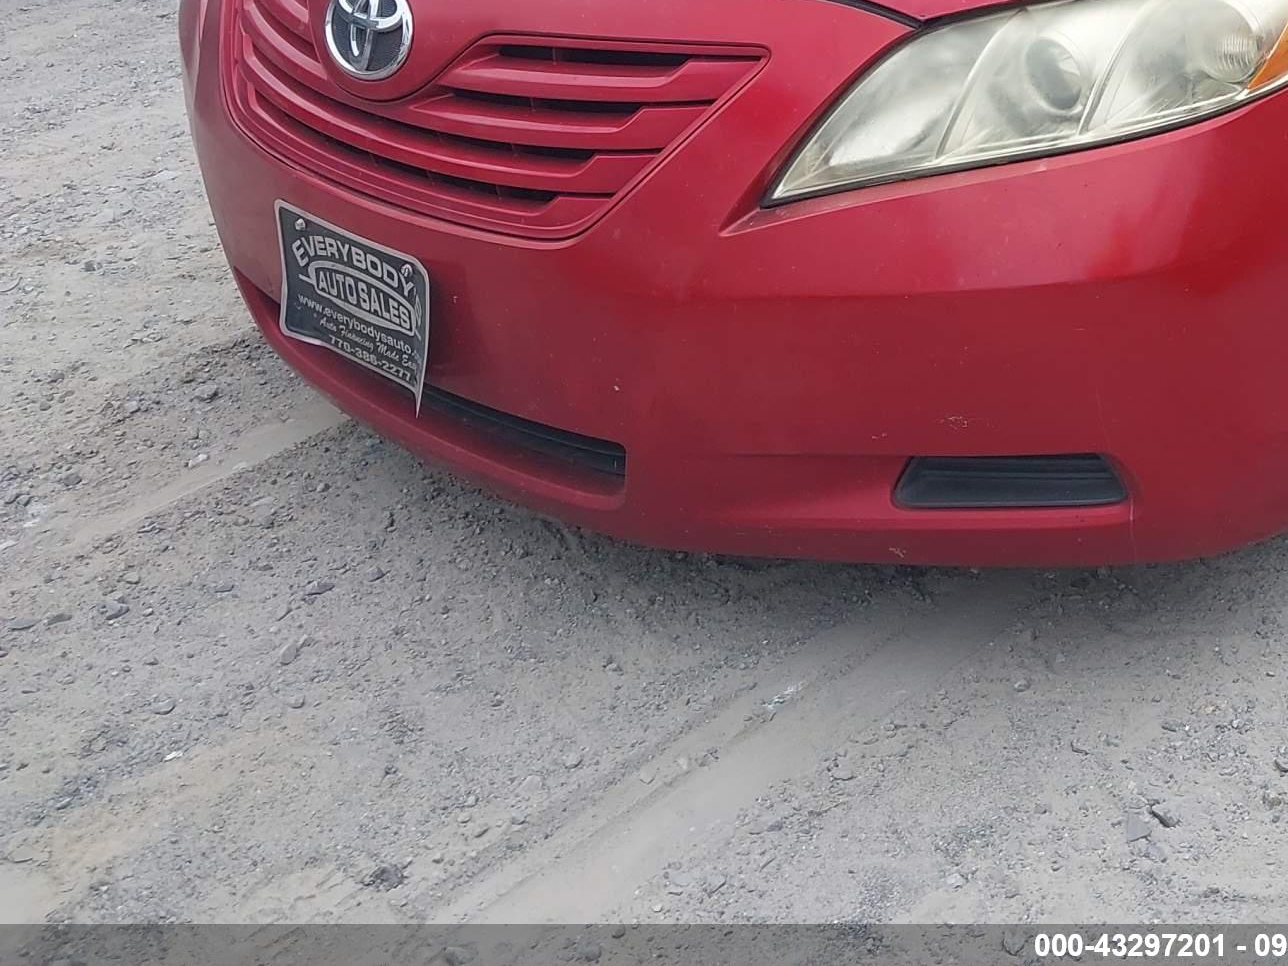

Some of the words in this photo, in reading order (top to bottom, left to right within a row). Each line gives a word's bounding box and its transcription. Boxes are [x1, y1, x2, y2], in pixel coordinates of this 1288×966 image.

[298, 295, 421, 362] www.everybodysauto.
[319, 271, 358, 305] AUTO
[358, 281, 411, 329] SALES
[320, 317, 337, 332] Auto
[376, 342, 399, 361] Made
